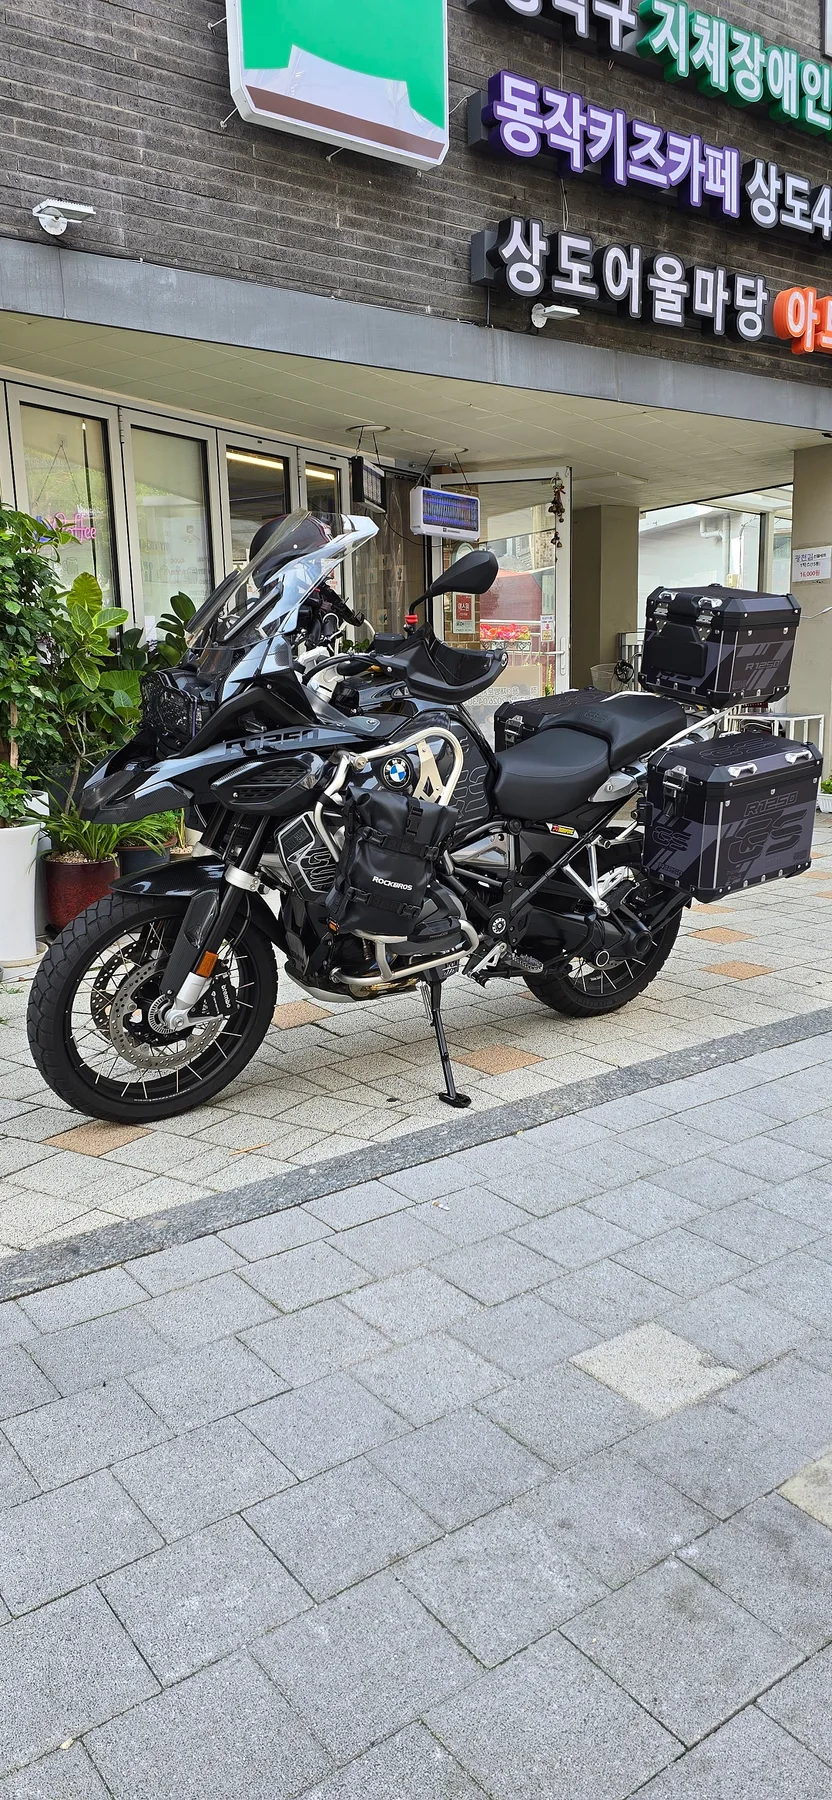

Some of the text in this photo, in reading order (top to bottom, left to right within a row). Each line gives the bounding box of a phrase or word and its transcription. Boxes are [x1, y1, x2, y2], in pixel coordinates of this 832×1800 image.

[649, 0, 832, 131] 지체장애인
[496, 74, 832, 239] 동작키즈카페 상도4
[500, 219, 768, 338] 상도어울마당
[744, 660, 780, 671] R1250
[743, 790, 799, 818] R1250
[371, 875, 413, 891] ROCKBROS
[220, 983, 232, 1009] brembo
